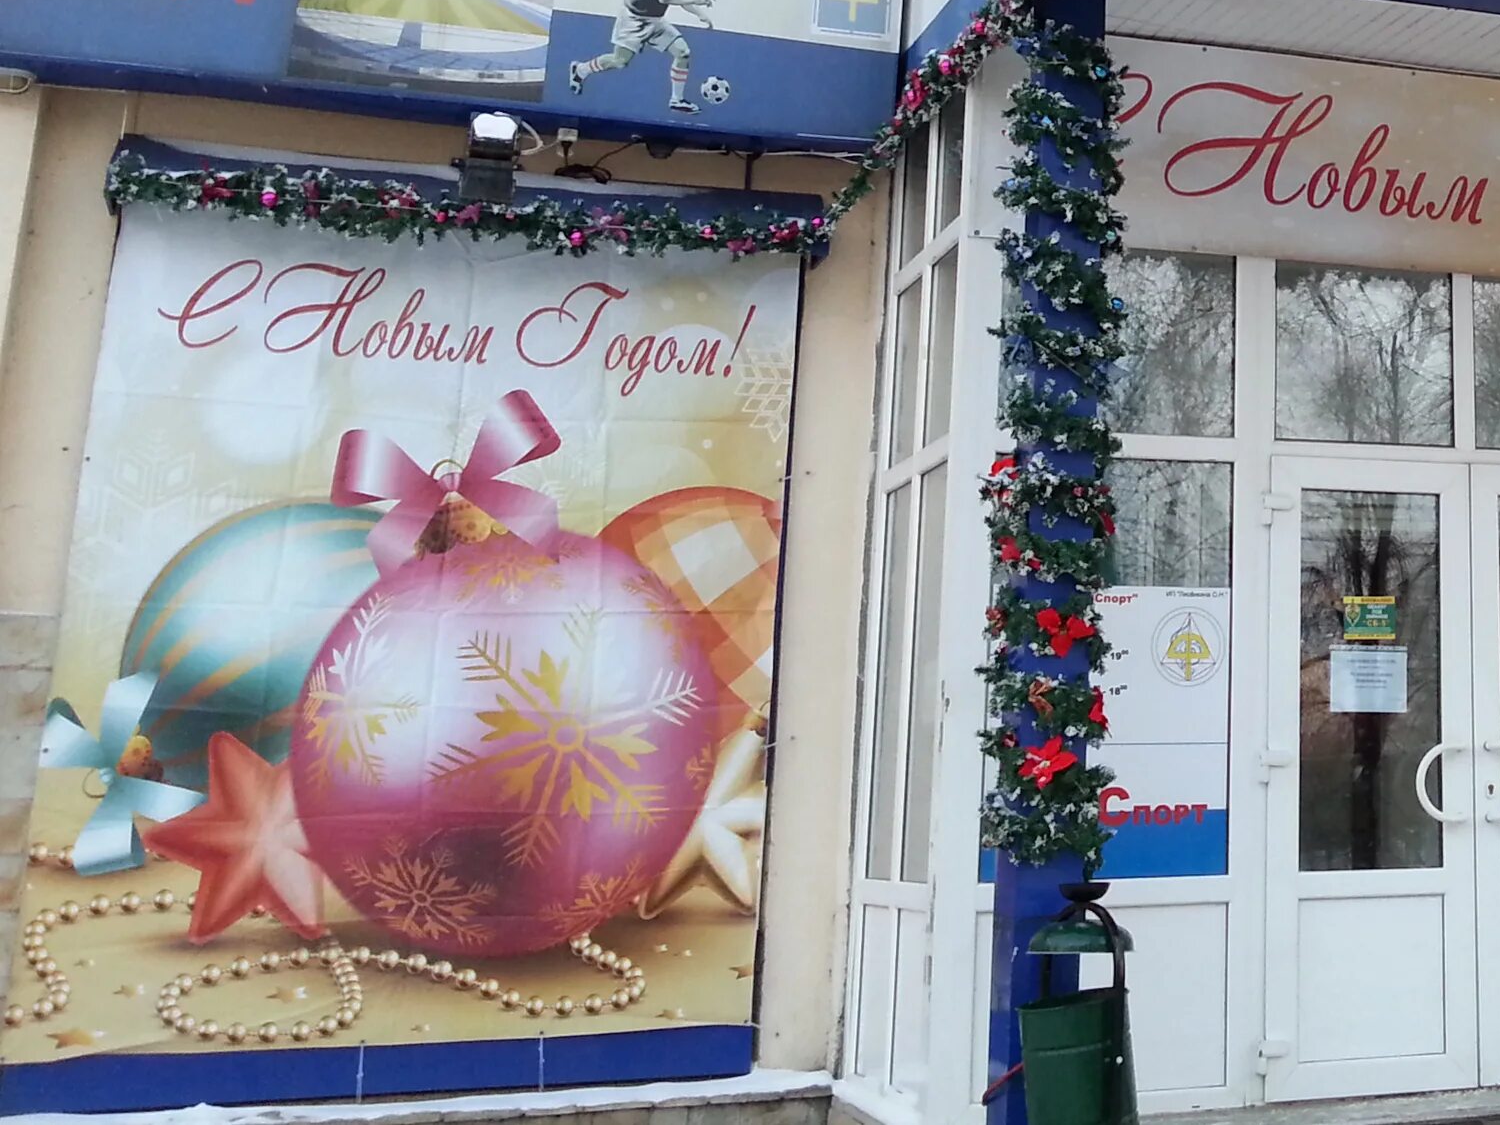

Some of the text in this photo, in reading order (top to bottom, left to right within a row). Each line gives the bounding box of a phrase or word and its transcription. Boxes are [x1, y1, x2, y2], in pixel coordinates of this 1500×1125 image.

[1156, 79, 1487, 228] Новым
[157, 258, 757, 398] С Новым Годом!
